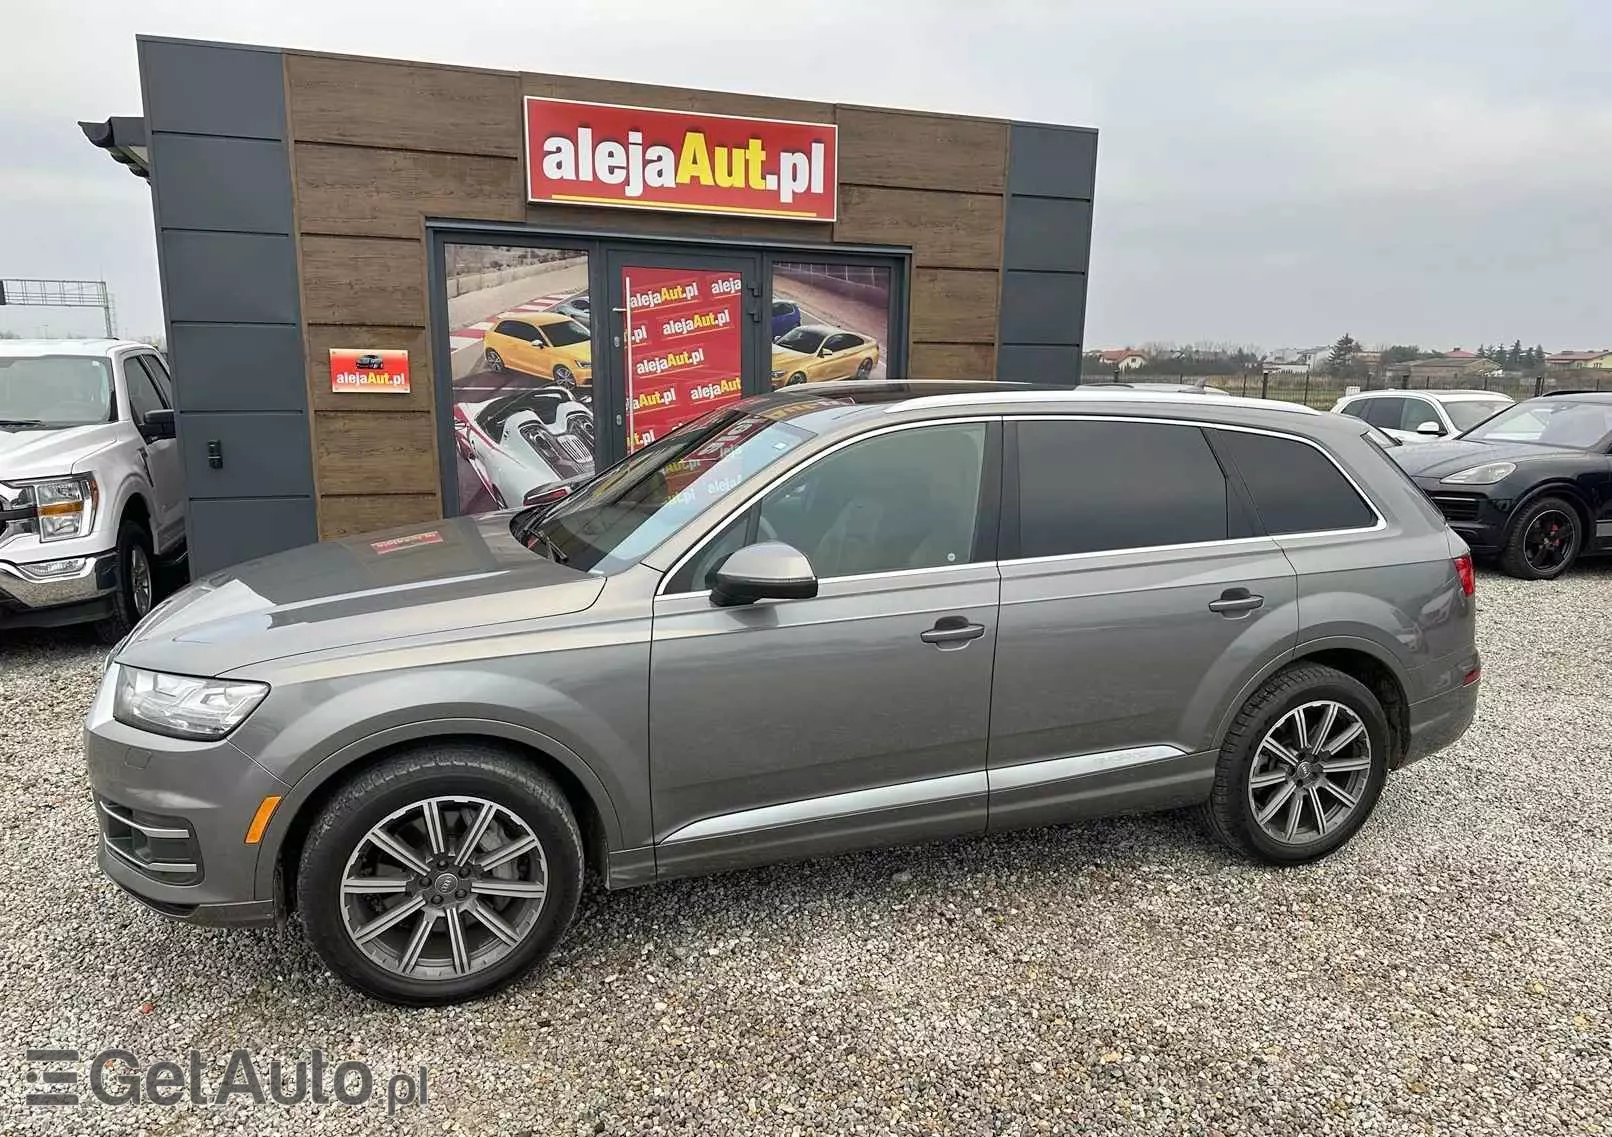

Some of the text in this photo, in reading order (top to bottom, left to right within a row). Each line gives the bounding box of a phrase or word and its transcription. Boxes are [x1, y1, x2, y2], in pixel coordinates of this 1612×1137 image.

[543, 128, 825, 203] alejaAut.pl
[630, 282, 698, 309] alejaAut.pl
[663, 309, 731, 336] alejaAut.pl
[636, 348, 705, 375] alejaAut.pl
[336, 371, 405, 387] alejaAut.pl
